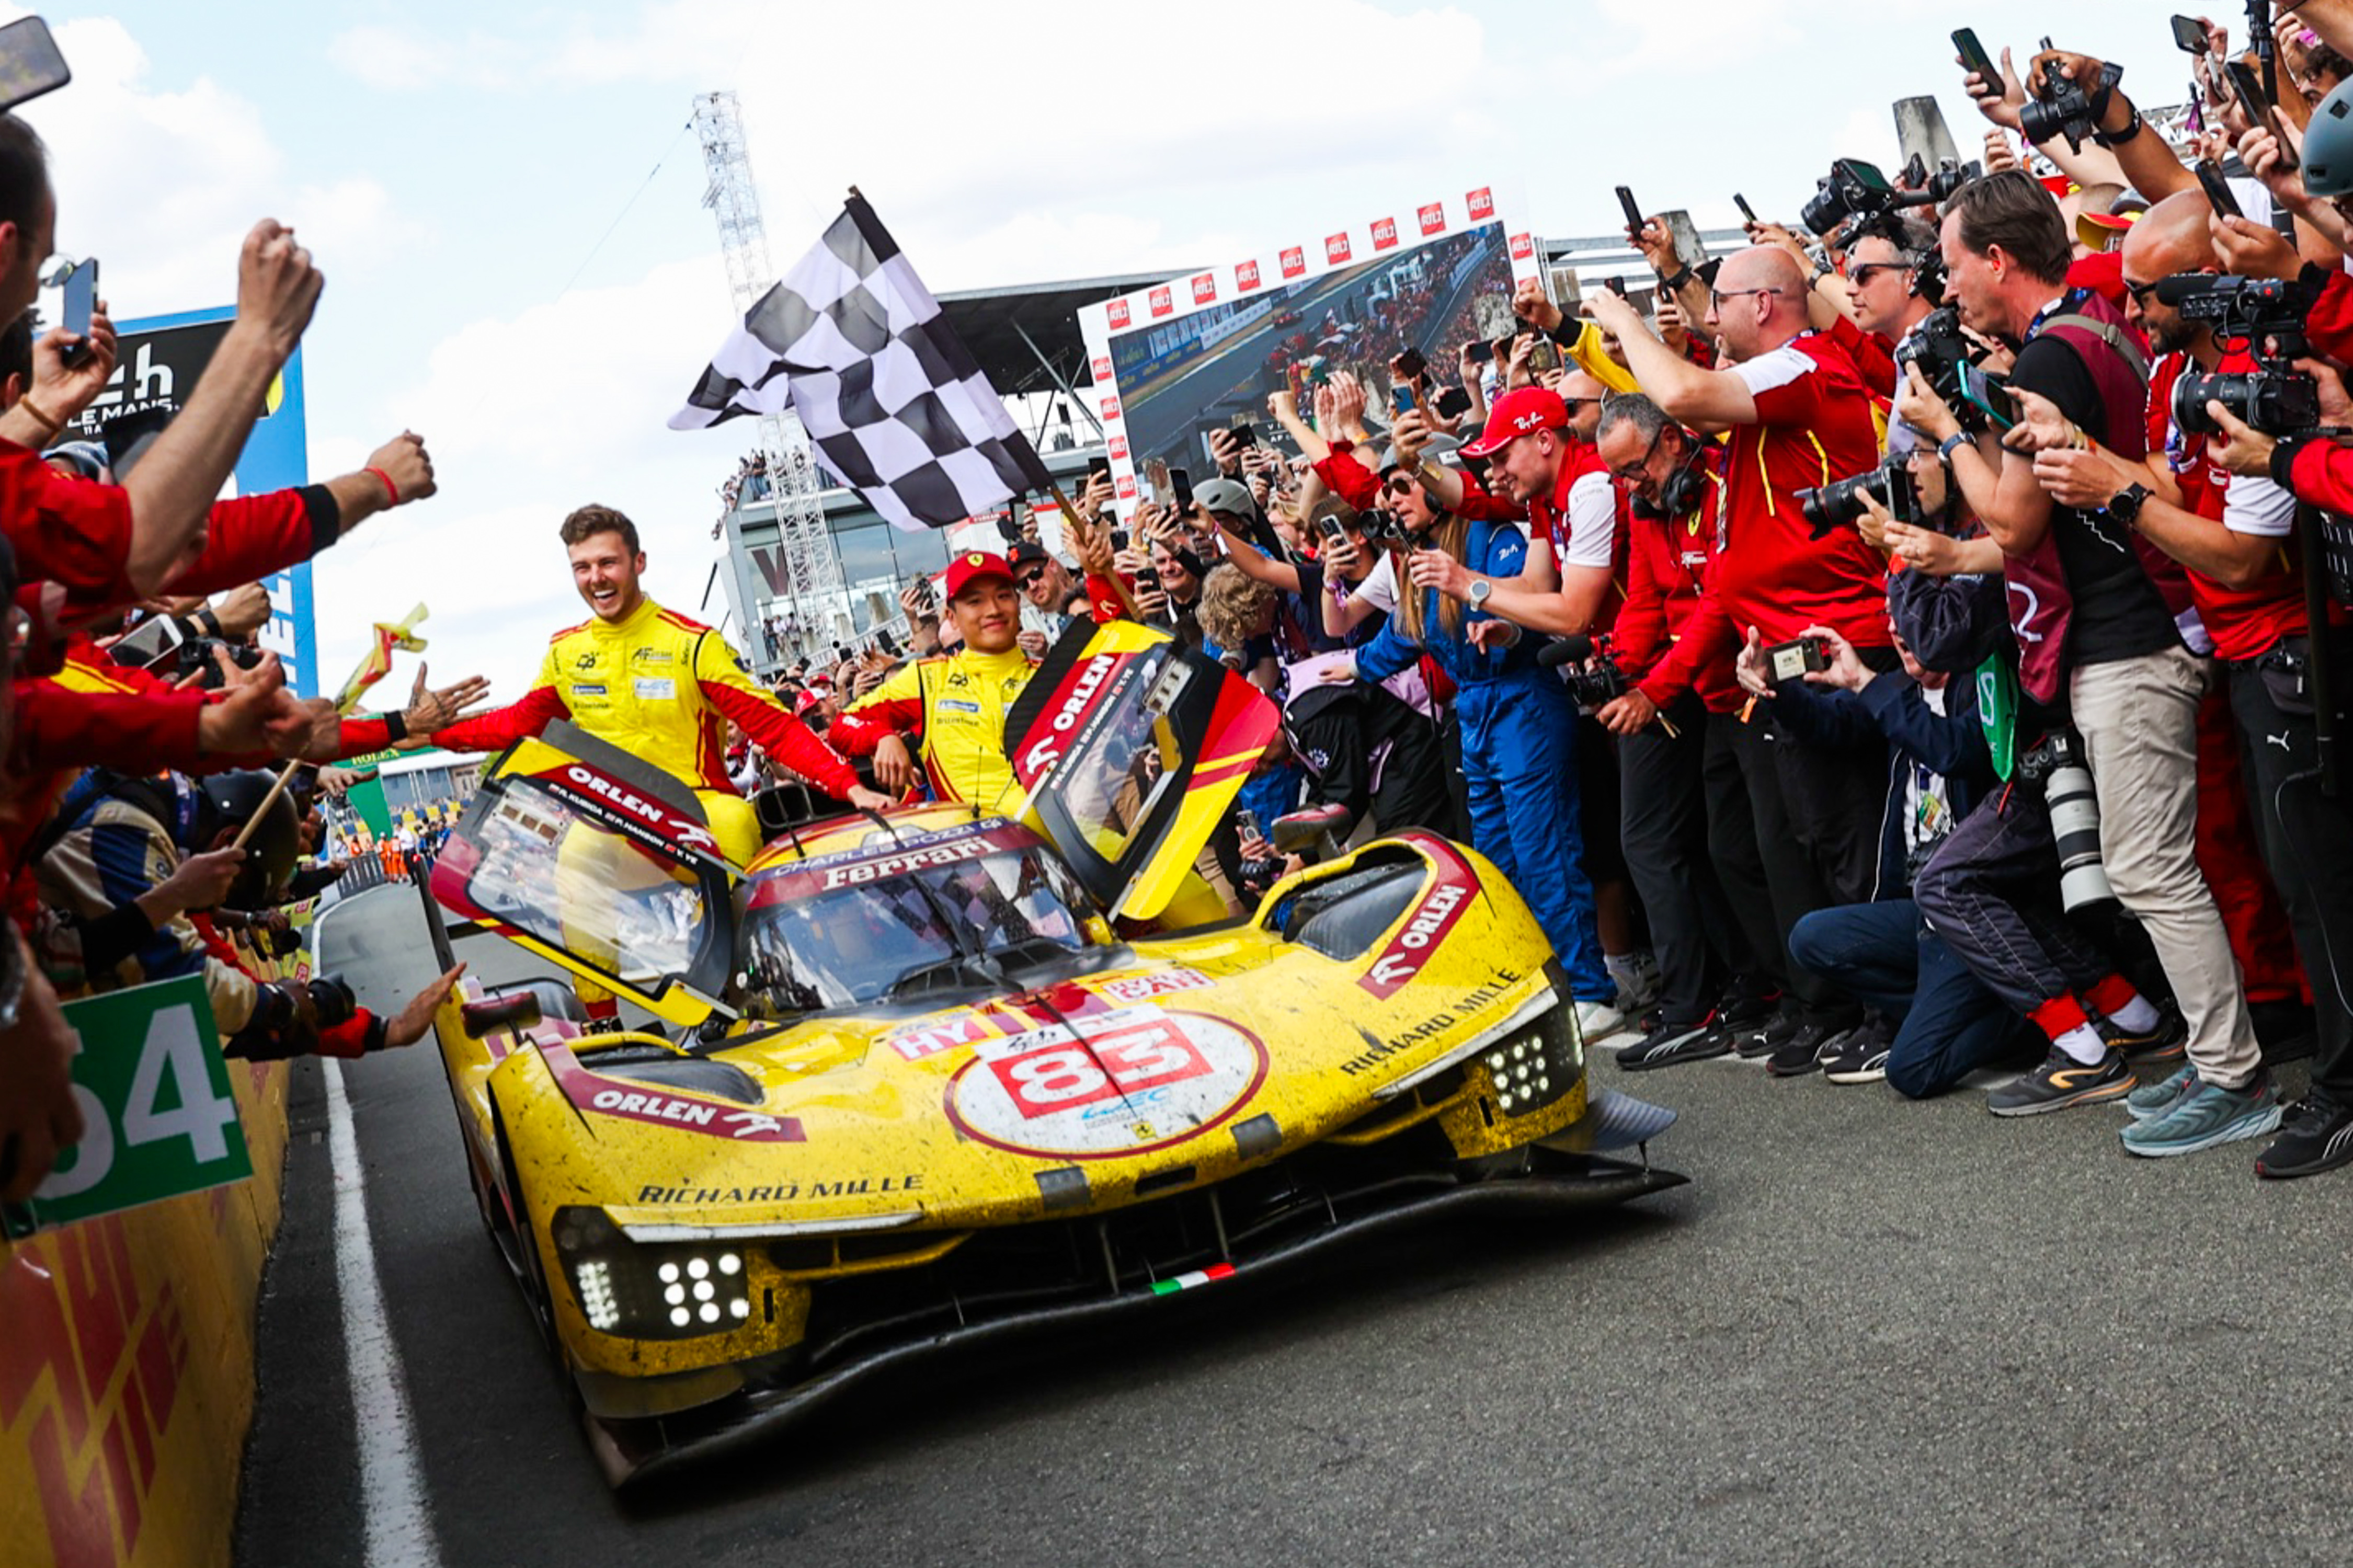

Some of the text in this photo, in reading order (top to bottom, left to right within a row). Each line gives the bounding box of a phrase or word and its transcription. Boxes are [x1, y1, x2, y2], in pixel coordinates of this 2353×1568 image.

[1054, 655, 1115, 731] ORLEN
[568, 767, 664, 822] ORLEN
[775, 826, 975, 877] CHARLES POZZI
[821, 836, 1002, 891] Ferrari
[1401, 885, 1467, 949] ORLEN
[1339, 967, 1522, 1077] RICHARD MILLE
[1010, 1027, 1192, 1103] 83
[593, 1091, 717, 1125] ORLEN
[637, 1174, 924, 1203] RICHARD MILLE
